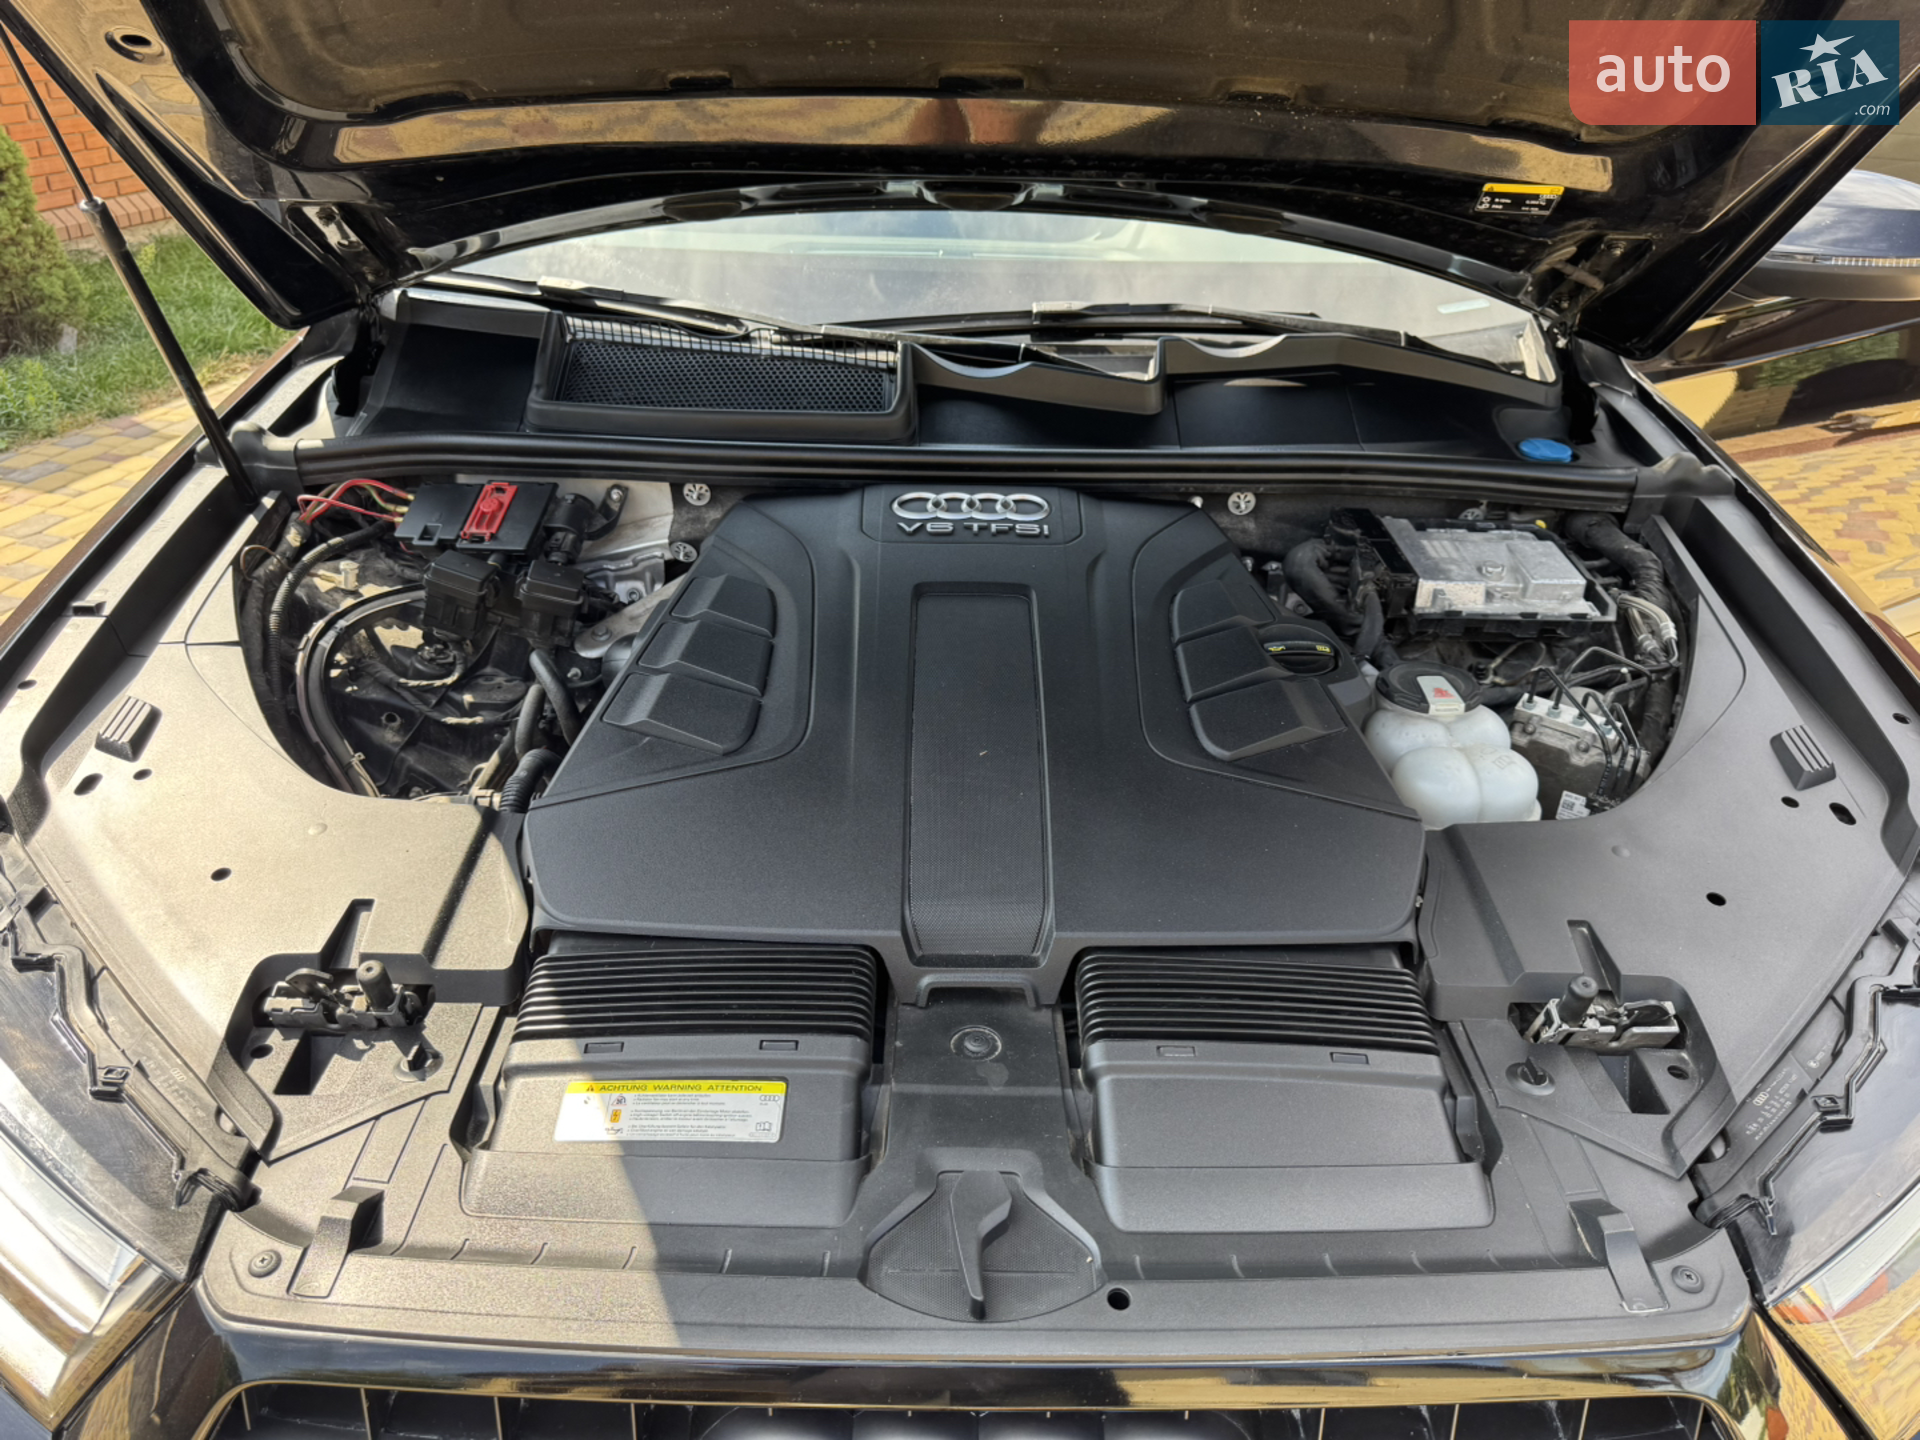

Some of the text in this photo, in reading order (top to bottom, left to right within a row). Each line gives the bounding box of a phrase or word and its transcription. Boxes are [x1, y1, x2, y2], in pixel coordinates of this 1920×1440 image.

[897, 522, 1050, 539] V6 TFSI
[599, 1083, 763, 1093] ACHTUNG WARNING ATTENTION
